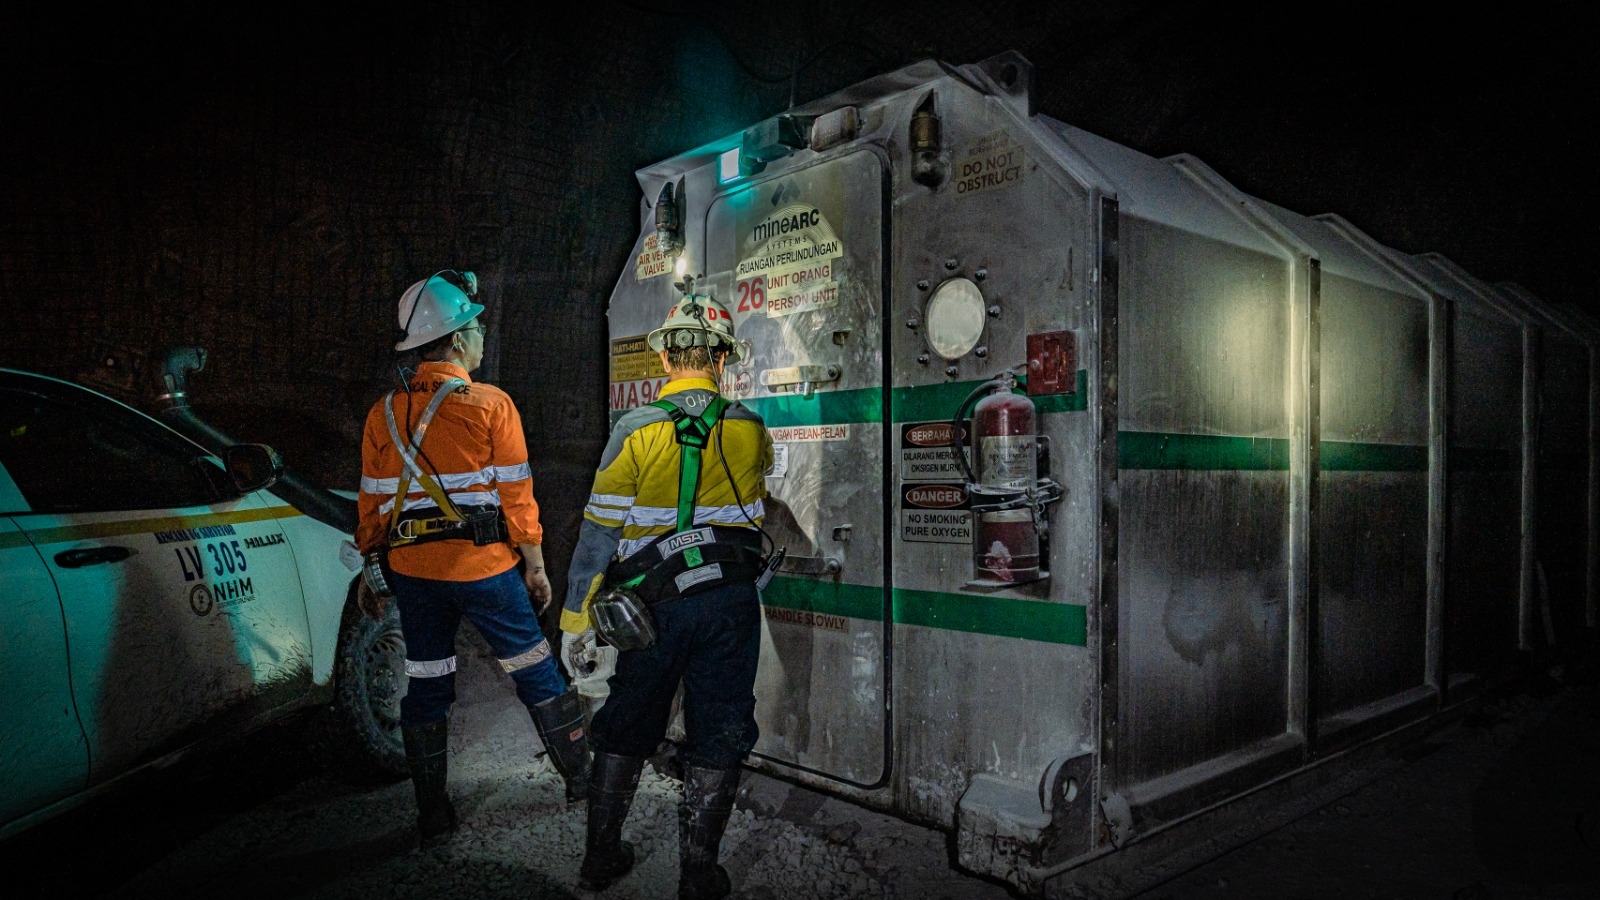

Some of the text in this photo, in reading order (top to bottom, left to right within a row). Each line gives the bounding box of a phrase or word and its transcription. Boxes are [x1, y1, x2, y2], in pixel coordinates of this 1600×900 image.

[963, 151, 1014, 177] DO NOT
[957, 165, 1022, 194] OBSTRUCT
[753, 208, 820, 242] mineARC
[766, 236, 808, 252] SYSTEMS
[639, 254, 651, 266] AIR
[740, 240, 838, 275] RUANGAN PERLINDUNGAN
[644, 261, 665, 276] VALVE
[737, 265, 830, 313] 26 UNIT ORANG
[767, 287, 837, 312] PERSON UNIT
[612, 341, 646, 354] HATI-HATI
[793, 426, 847, 440] PELAN-PELAN
[911, 429, 956, 441] BERBAHAY
[903, 450, 935, 461] DILARANG
[911, 463, 938, 473] OKSIGEN
[912, 490, 961, 503] DANGER
[908, 514, 966, 525] NO SMOKING
[905, 525, 970, 538] PURE OXYGEN
[669, 532, 704, 550] MSA
[175, 532, 286, 581] LV 305 HILUX
[213, 576, 254, 602] NHM
[765, 609, 846, 630] HANDLE SLOWLY
